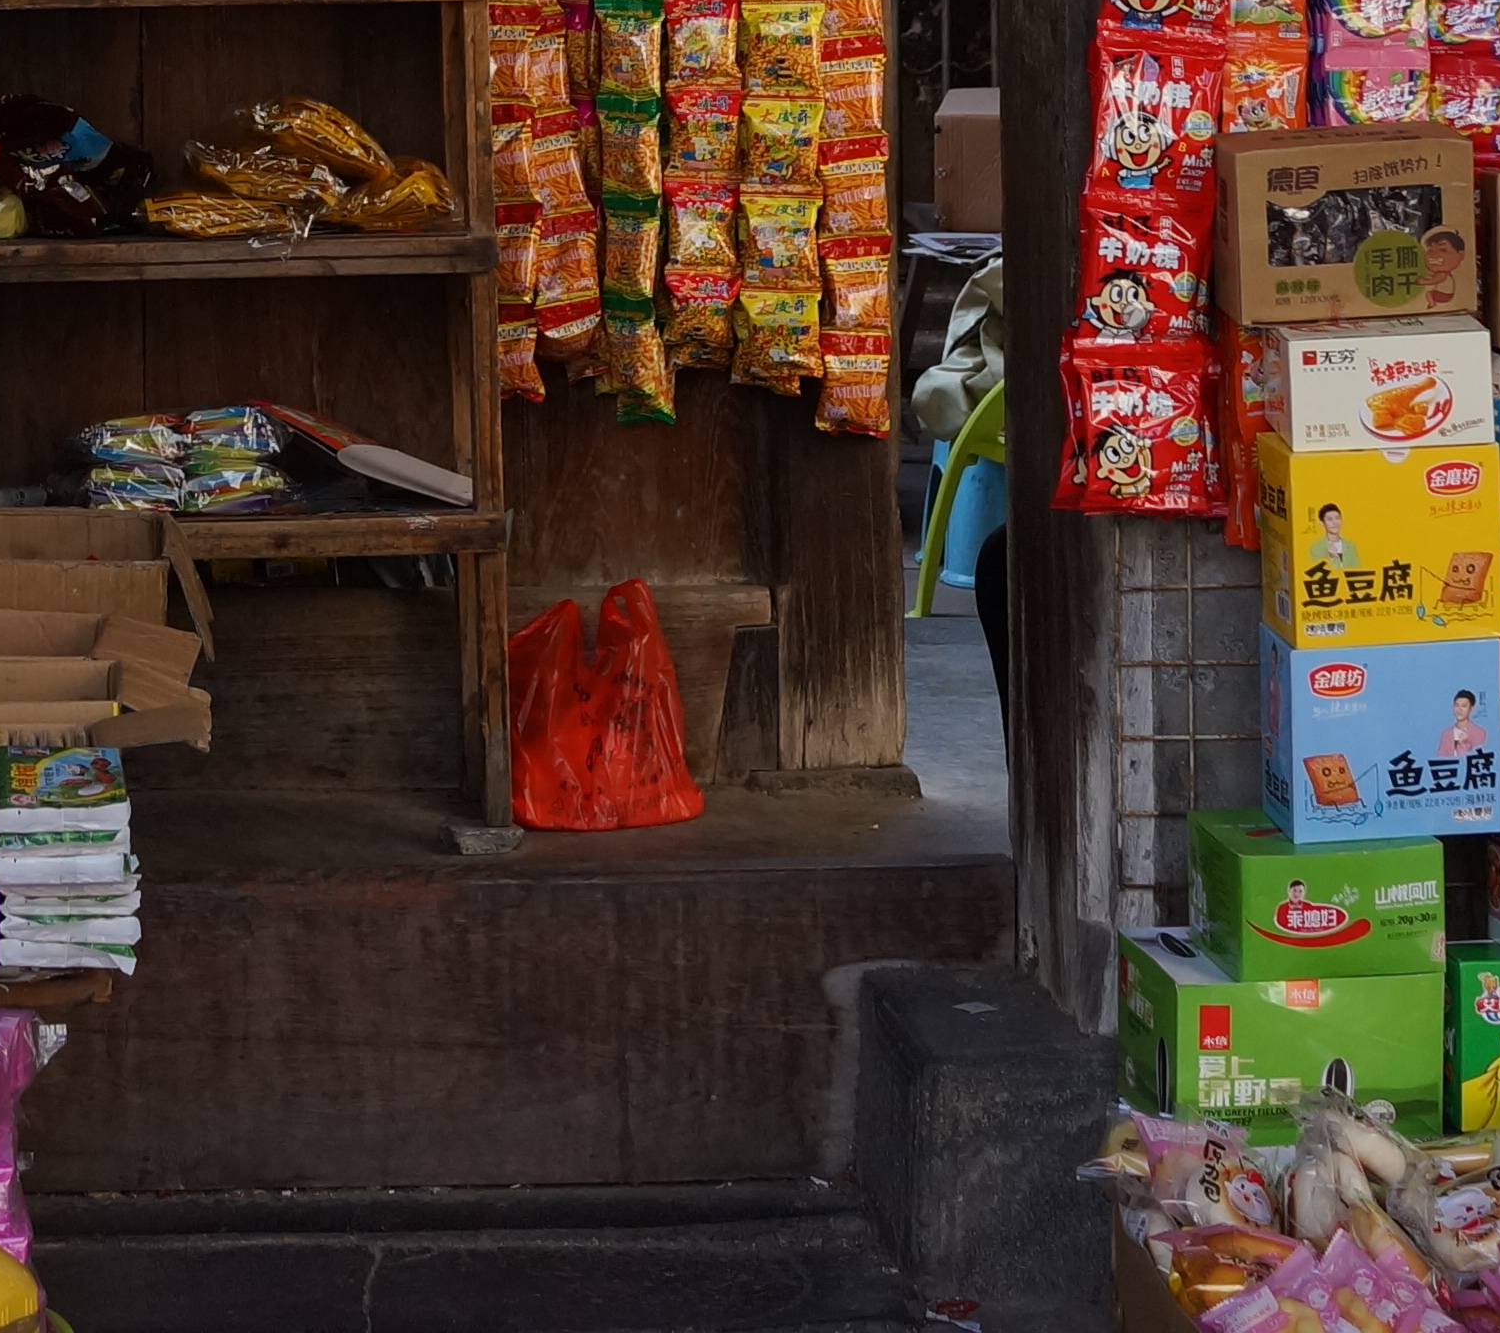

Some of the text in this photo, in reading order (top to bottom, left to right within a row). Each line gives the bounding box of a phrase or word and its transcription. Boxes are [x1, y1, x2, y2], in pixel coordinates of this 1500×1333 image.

[1429, 466, 1480, 490] 金磨坊
[1301, 559, 1414, 609] 鱼豆腐
[1312, 668, 1366, 691] 金磨坊
[1385, 750, 1497, 798] 鱼豆腐
